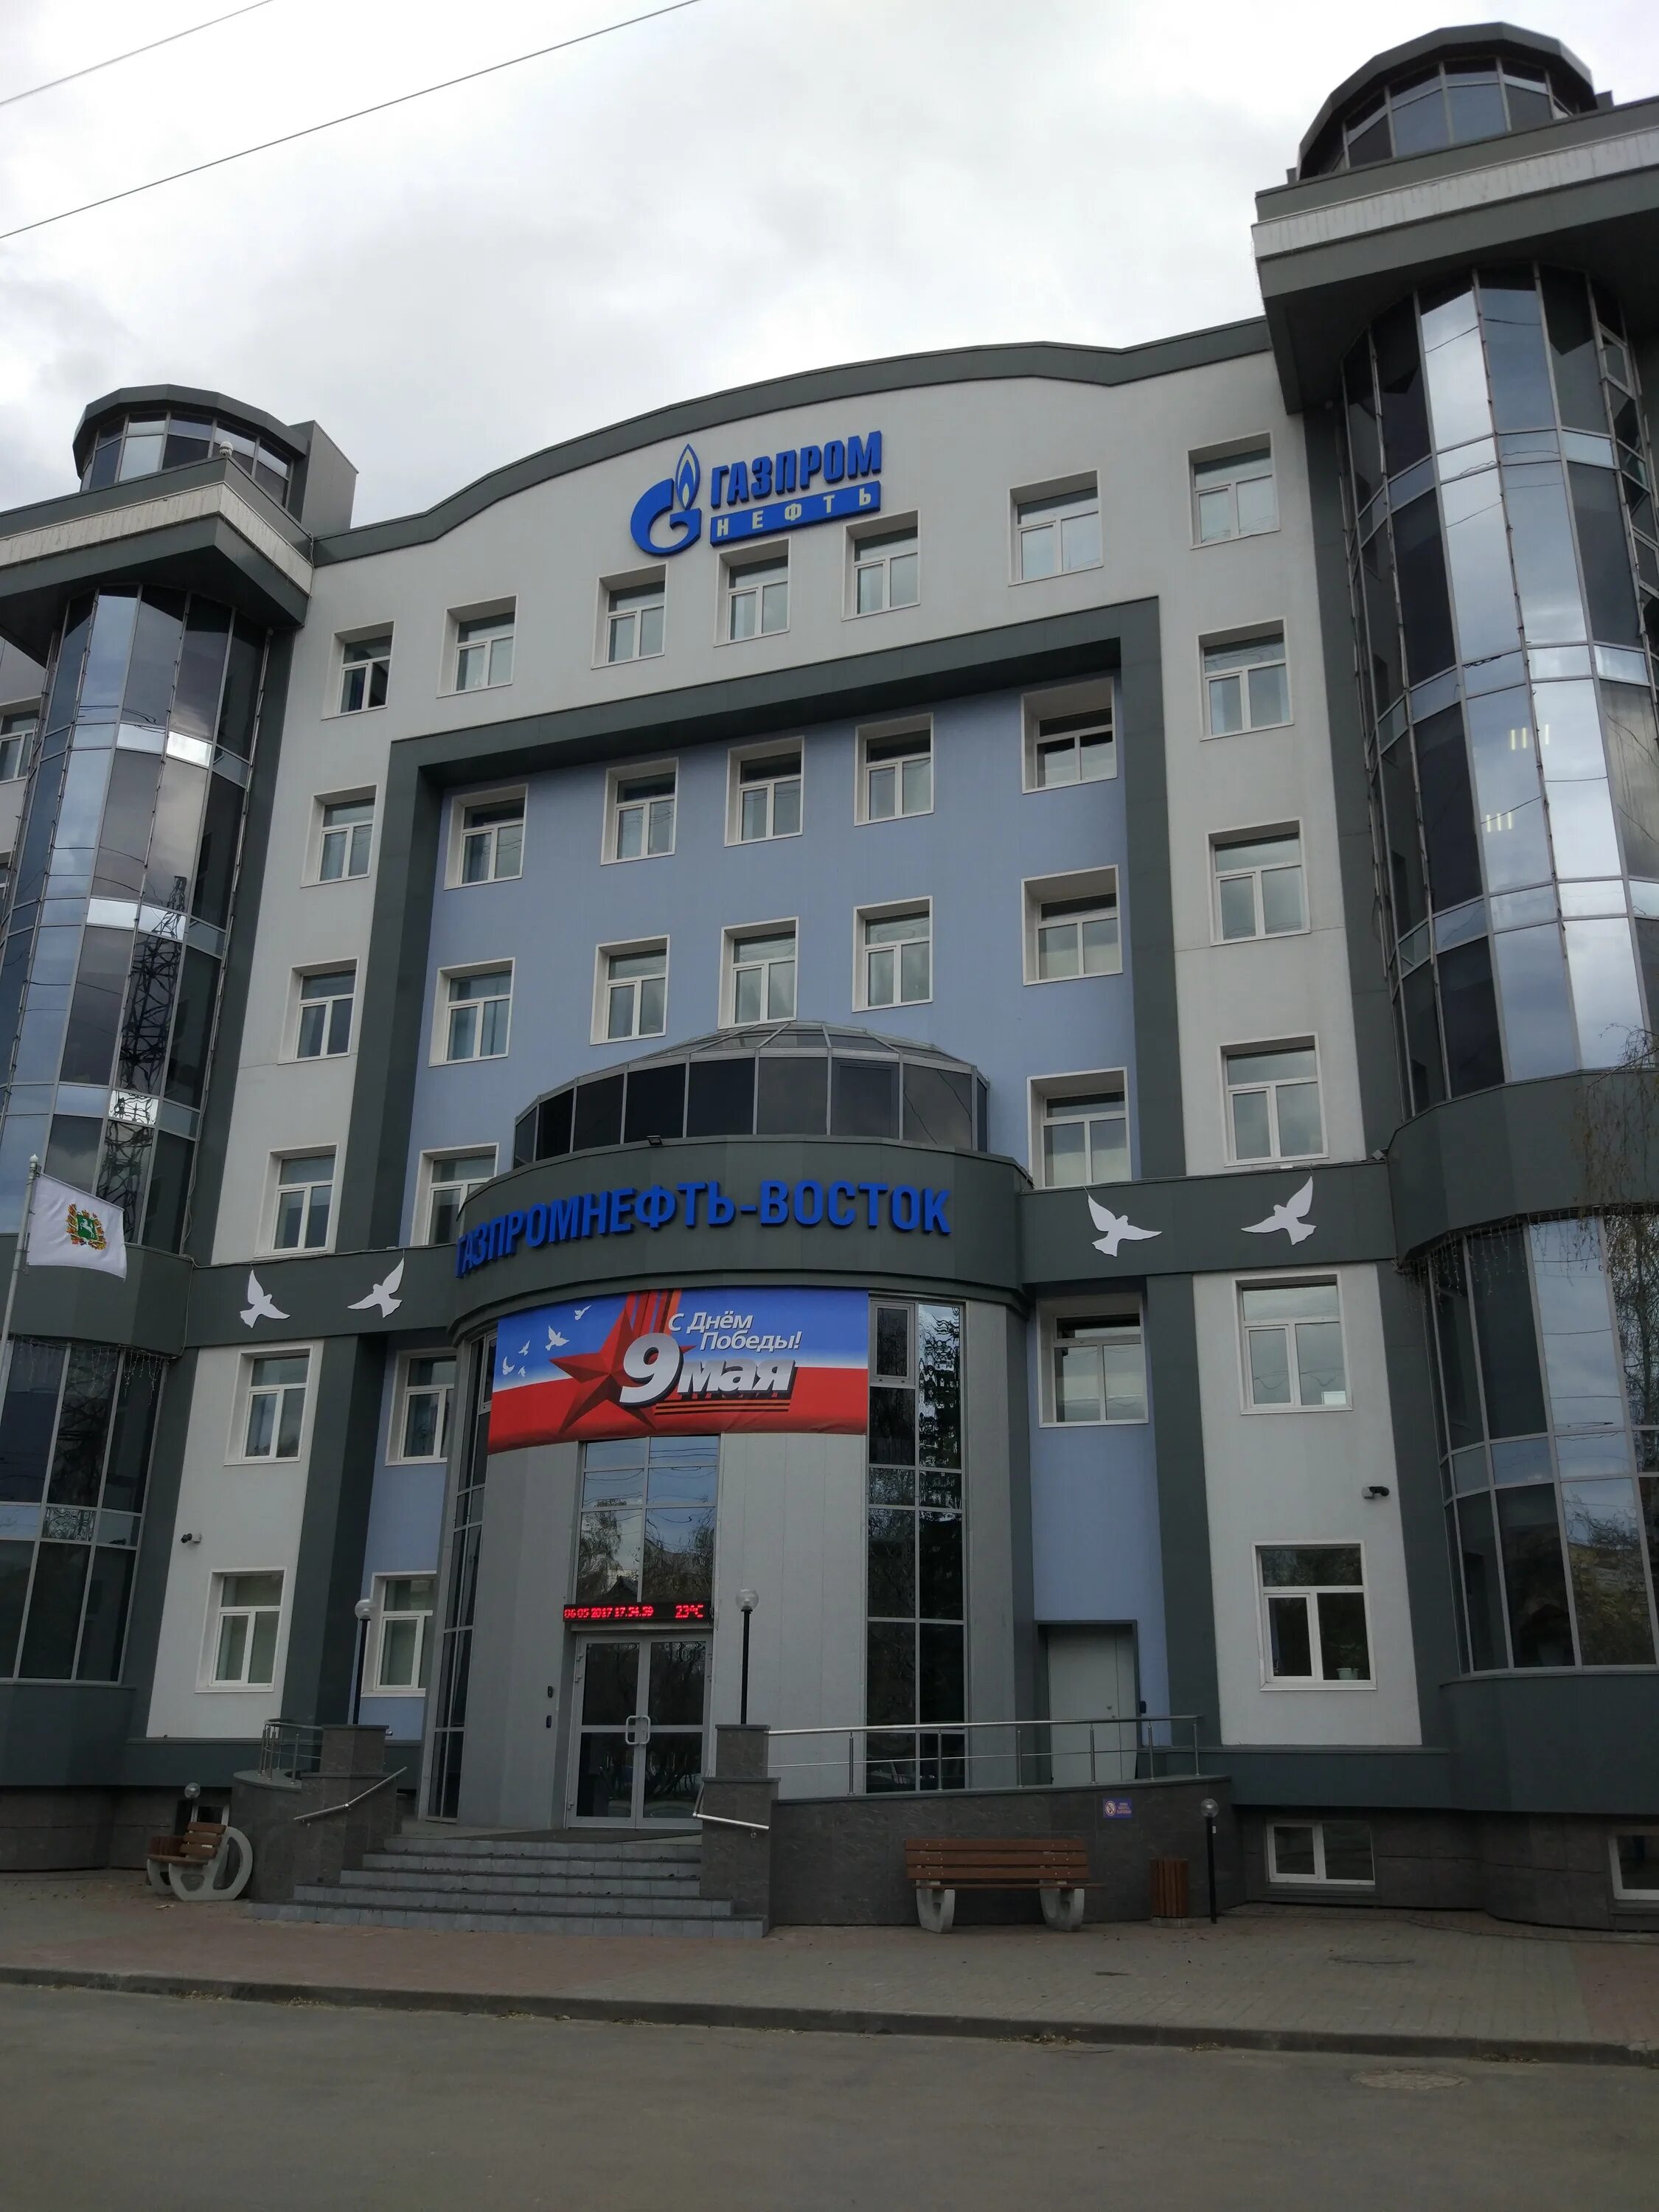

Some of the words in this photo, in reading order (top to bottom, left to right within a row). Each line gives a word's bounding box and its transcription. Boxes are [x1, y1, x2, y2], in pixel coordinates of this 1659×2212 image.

[711, 430, 882, 509] ГАЗПРОМ
[717, 487, 872, 537] НЕФТЬ
[454, 1180, 951, 1279] ГАЗПРОМНЕФТЬ-ВОСТОК
[686, 1310, 754, 1335] Днём
[700, 1330, 803, 1353] Победы!
[619, 1332, 683, 1407] 9
